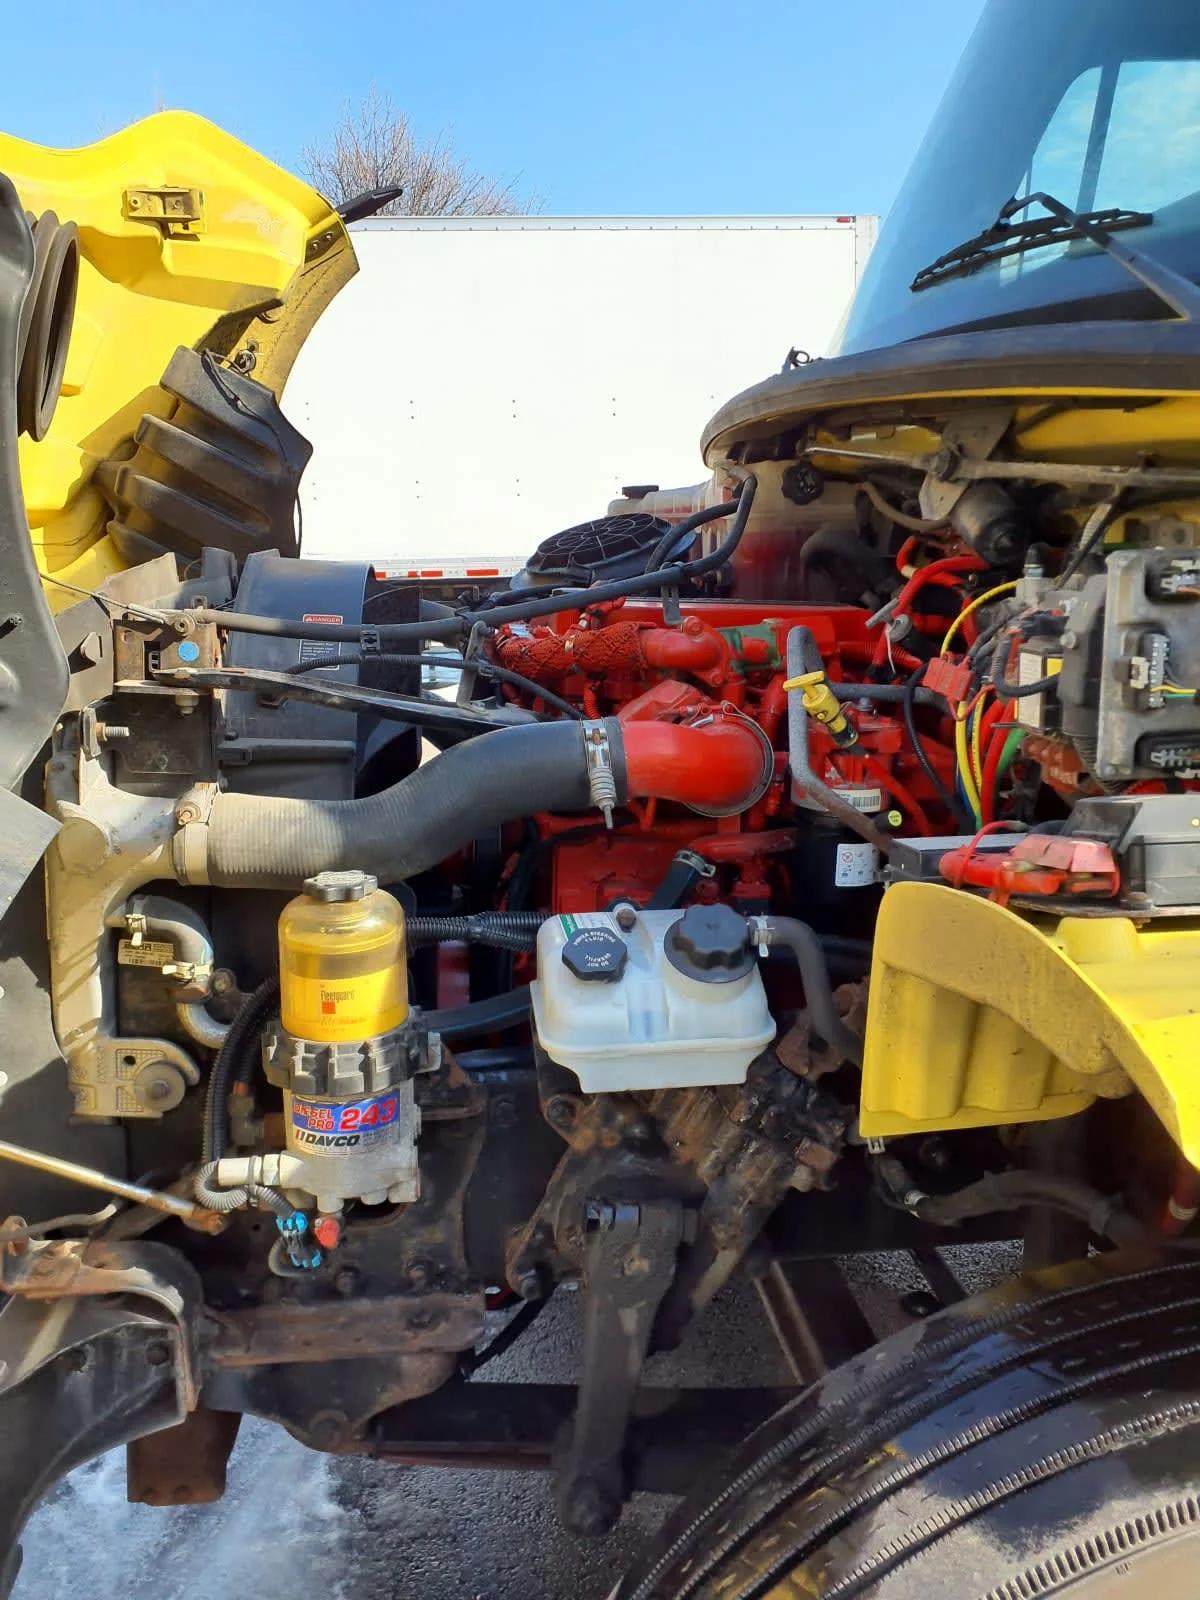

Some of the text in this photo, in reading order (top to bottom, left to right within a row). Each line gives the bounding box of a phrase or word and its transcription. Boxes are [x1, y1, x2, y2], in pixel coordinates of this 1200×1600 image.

[340, 1098, 397, 1131] 243
[309, 1118, 334, 1130] PRO
[304, 1133, 360, 1147] DAVCO
